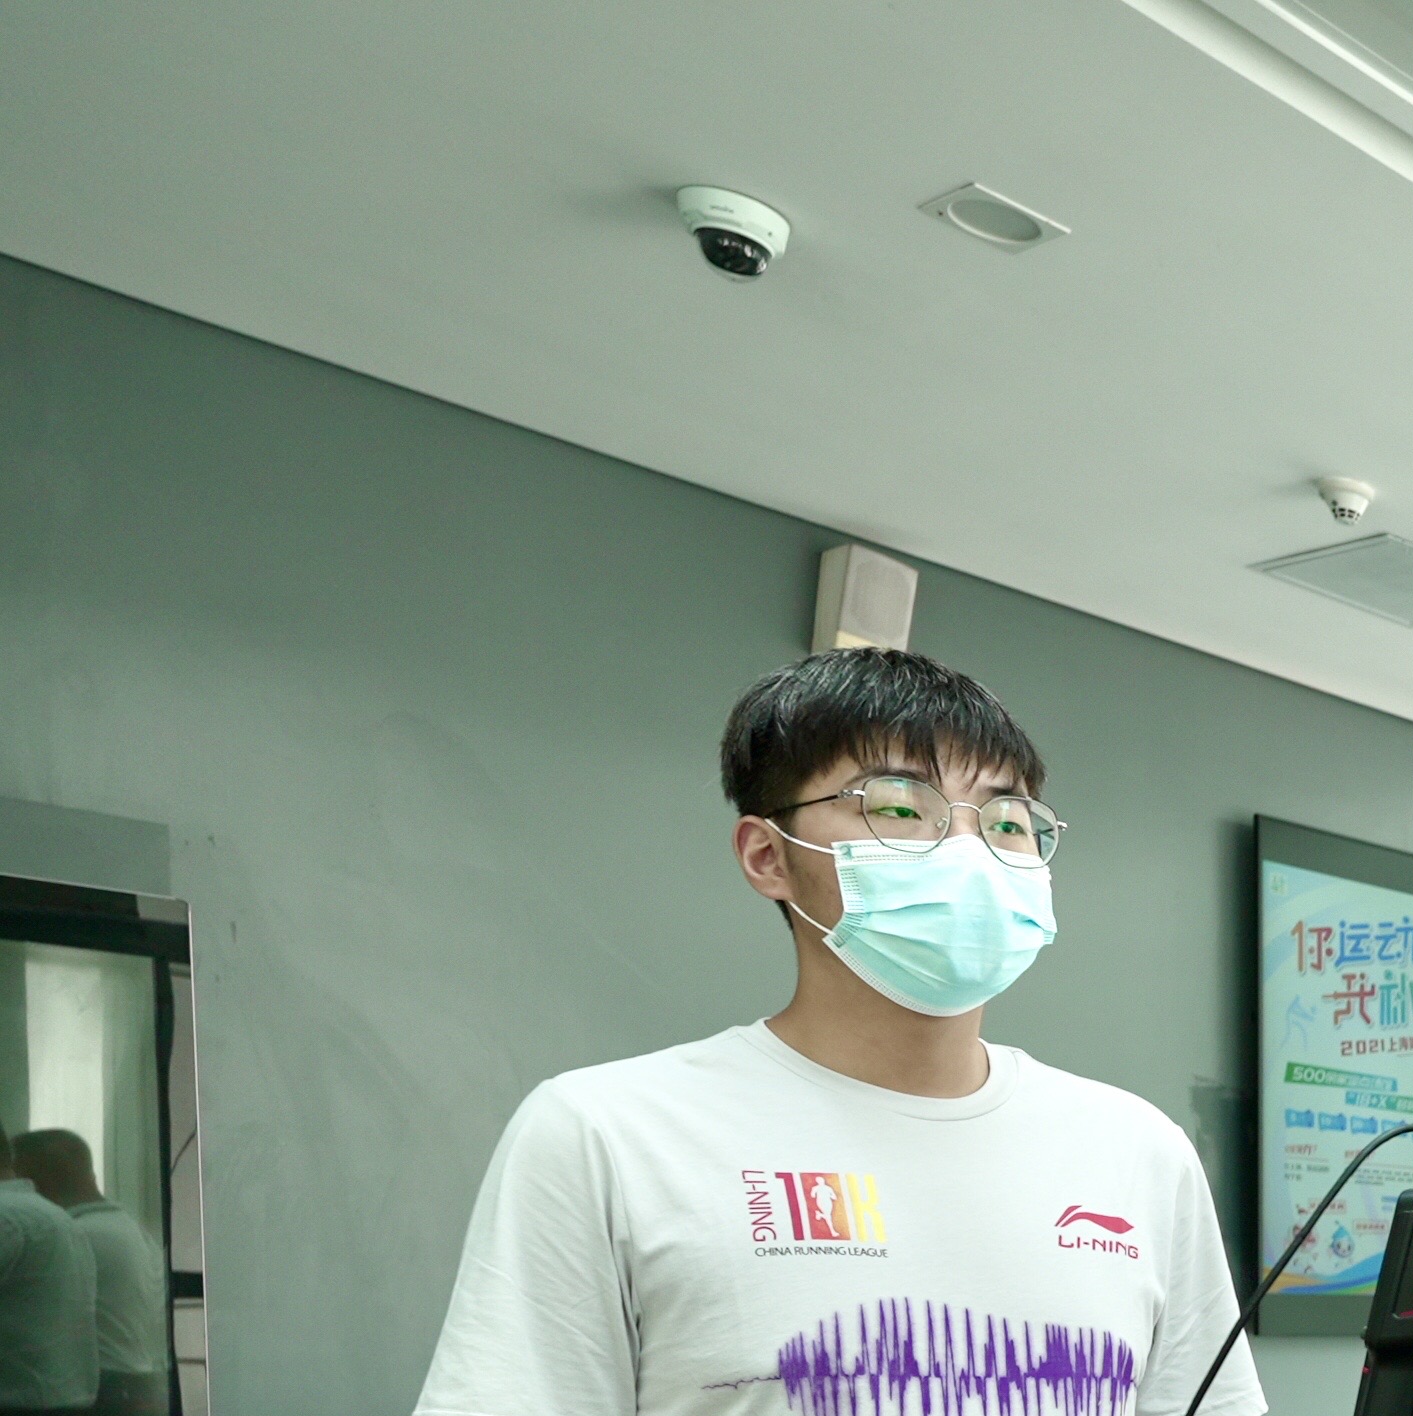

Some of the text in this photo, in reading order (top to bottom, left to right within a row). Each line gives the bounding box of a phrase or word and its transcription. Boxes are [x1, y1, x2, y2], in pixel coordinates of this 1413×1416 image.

[742, 1170, 777, 1243] LI-NING
[754, 1246, 889, 1259] CHINA RUNNING LEAGUE
[1058, 1234, 1139, 1260] LI-NING
